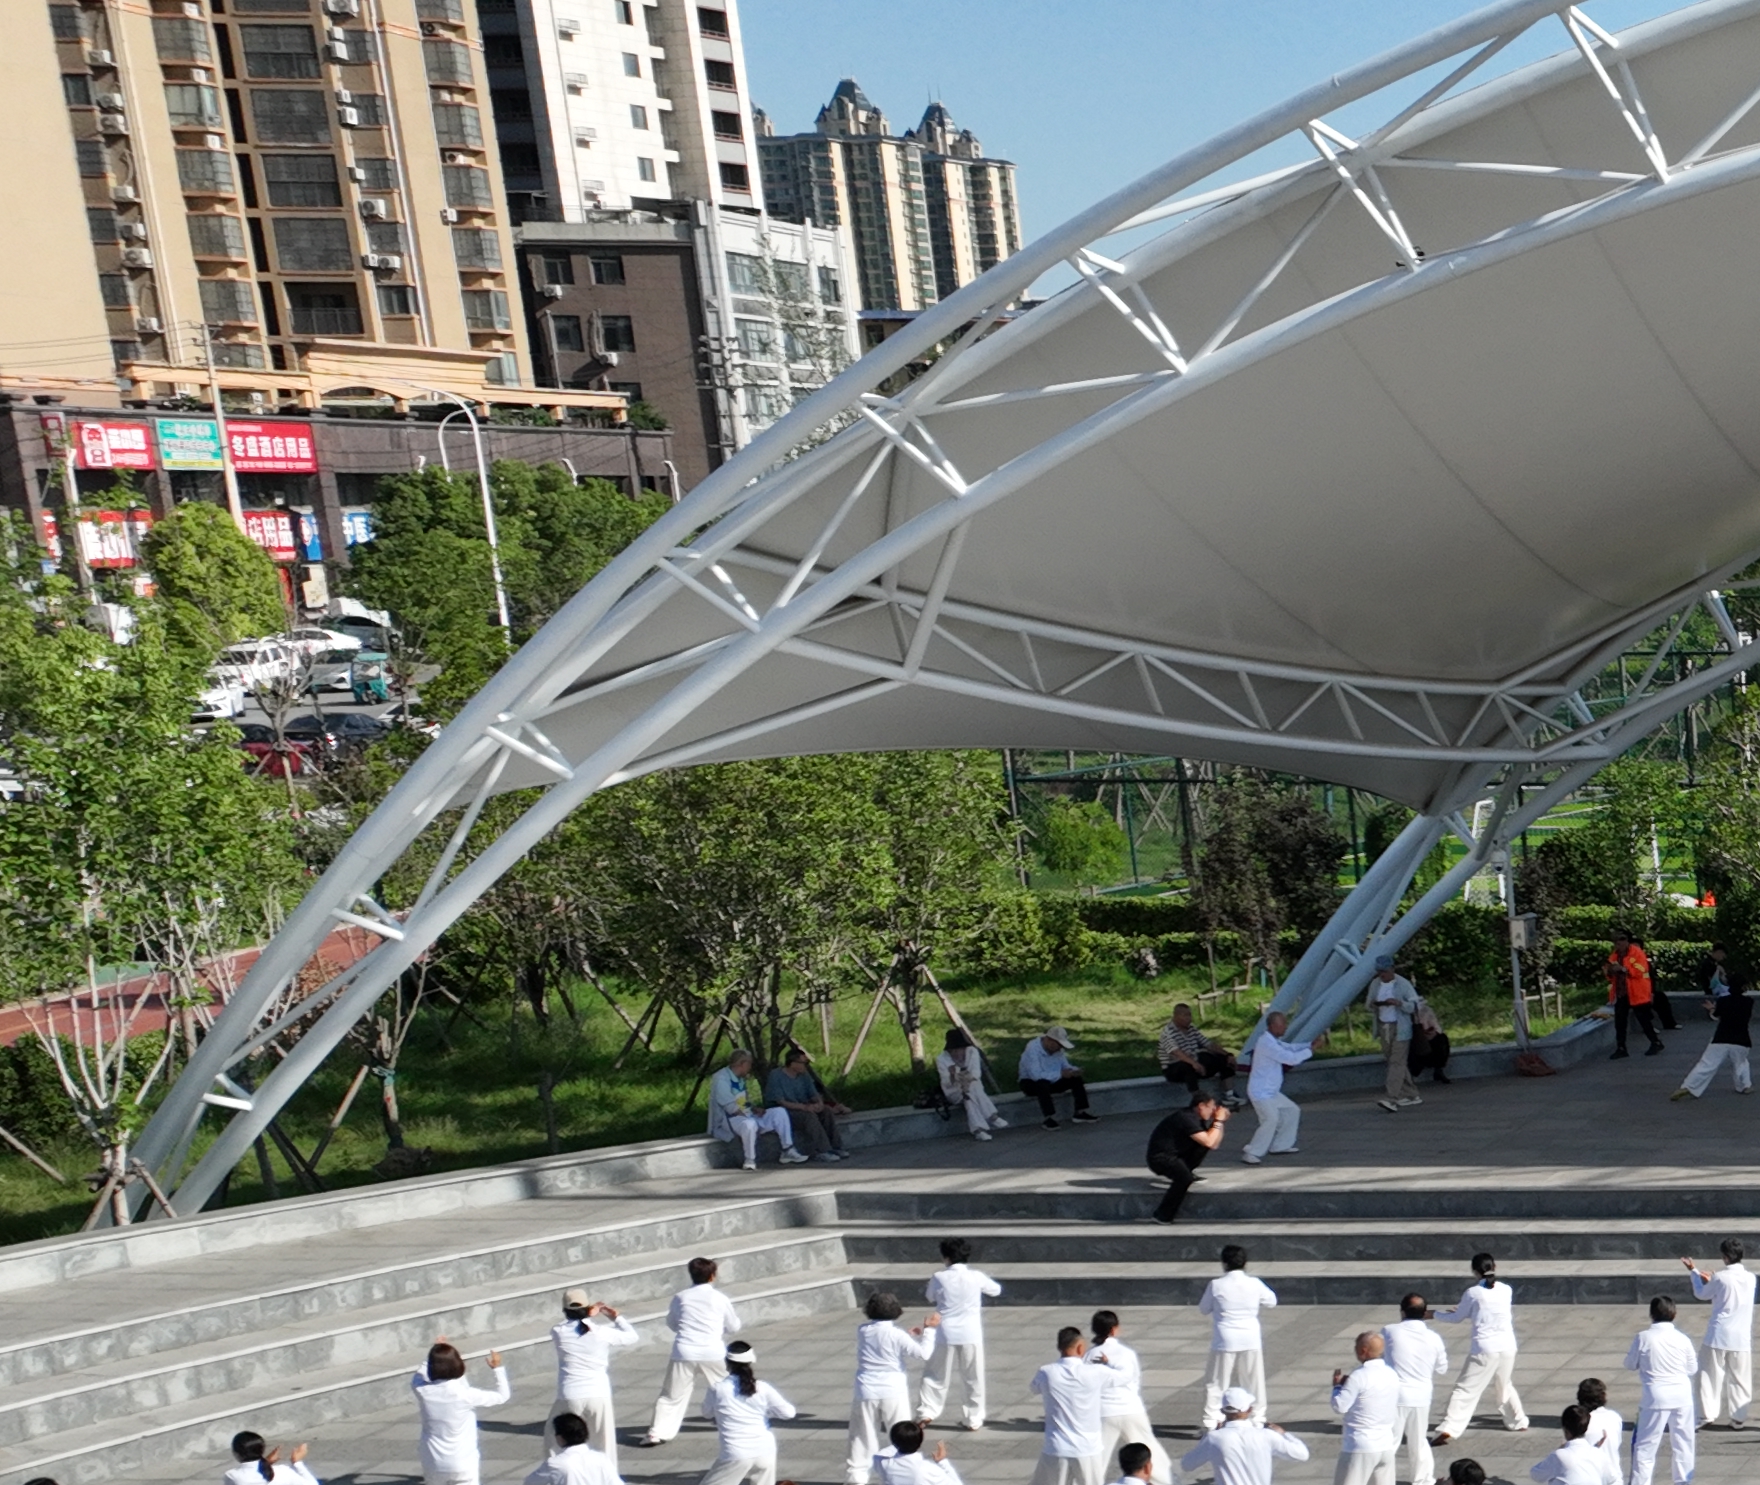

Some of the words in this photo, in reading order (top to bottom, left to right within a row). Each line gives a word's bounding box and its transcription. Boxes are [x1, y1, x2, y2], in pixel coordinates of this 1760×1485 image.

[231, 435, 312, 459] 冬盛酒店用品
[244, 516, 294, 547] 店用品
